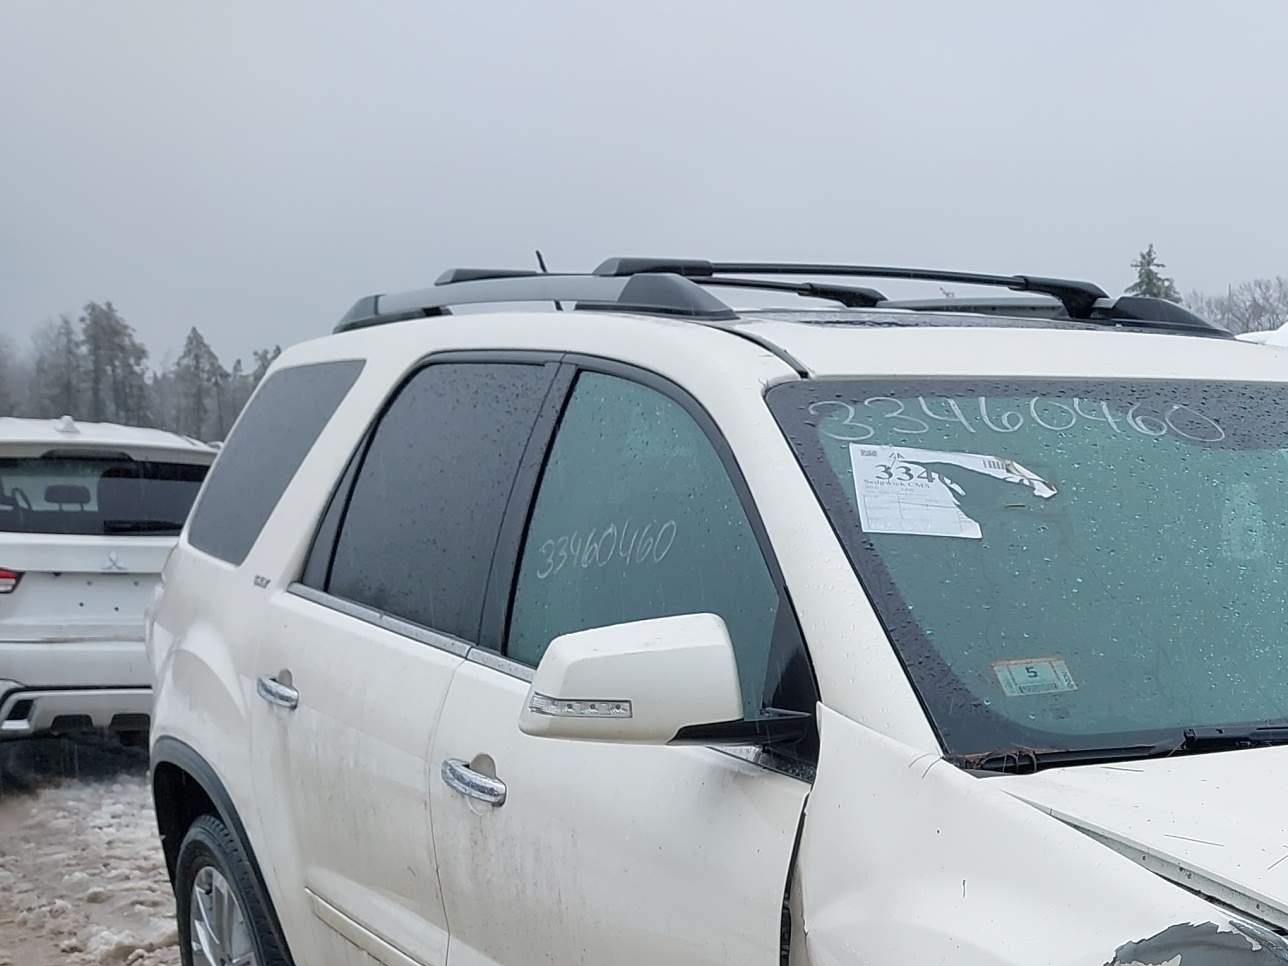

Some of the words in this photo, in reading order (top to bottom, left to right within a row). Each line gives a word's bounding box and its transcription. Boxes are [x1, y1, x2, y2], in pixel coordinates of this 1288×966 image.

[808, 396, 1226, 443] 33460460
[876, 464, 945, 483] 334
[536, 519, 677, 579] 33460460
[1025, 666, 1038, 678] 5
